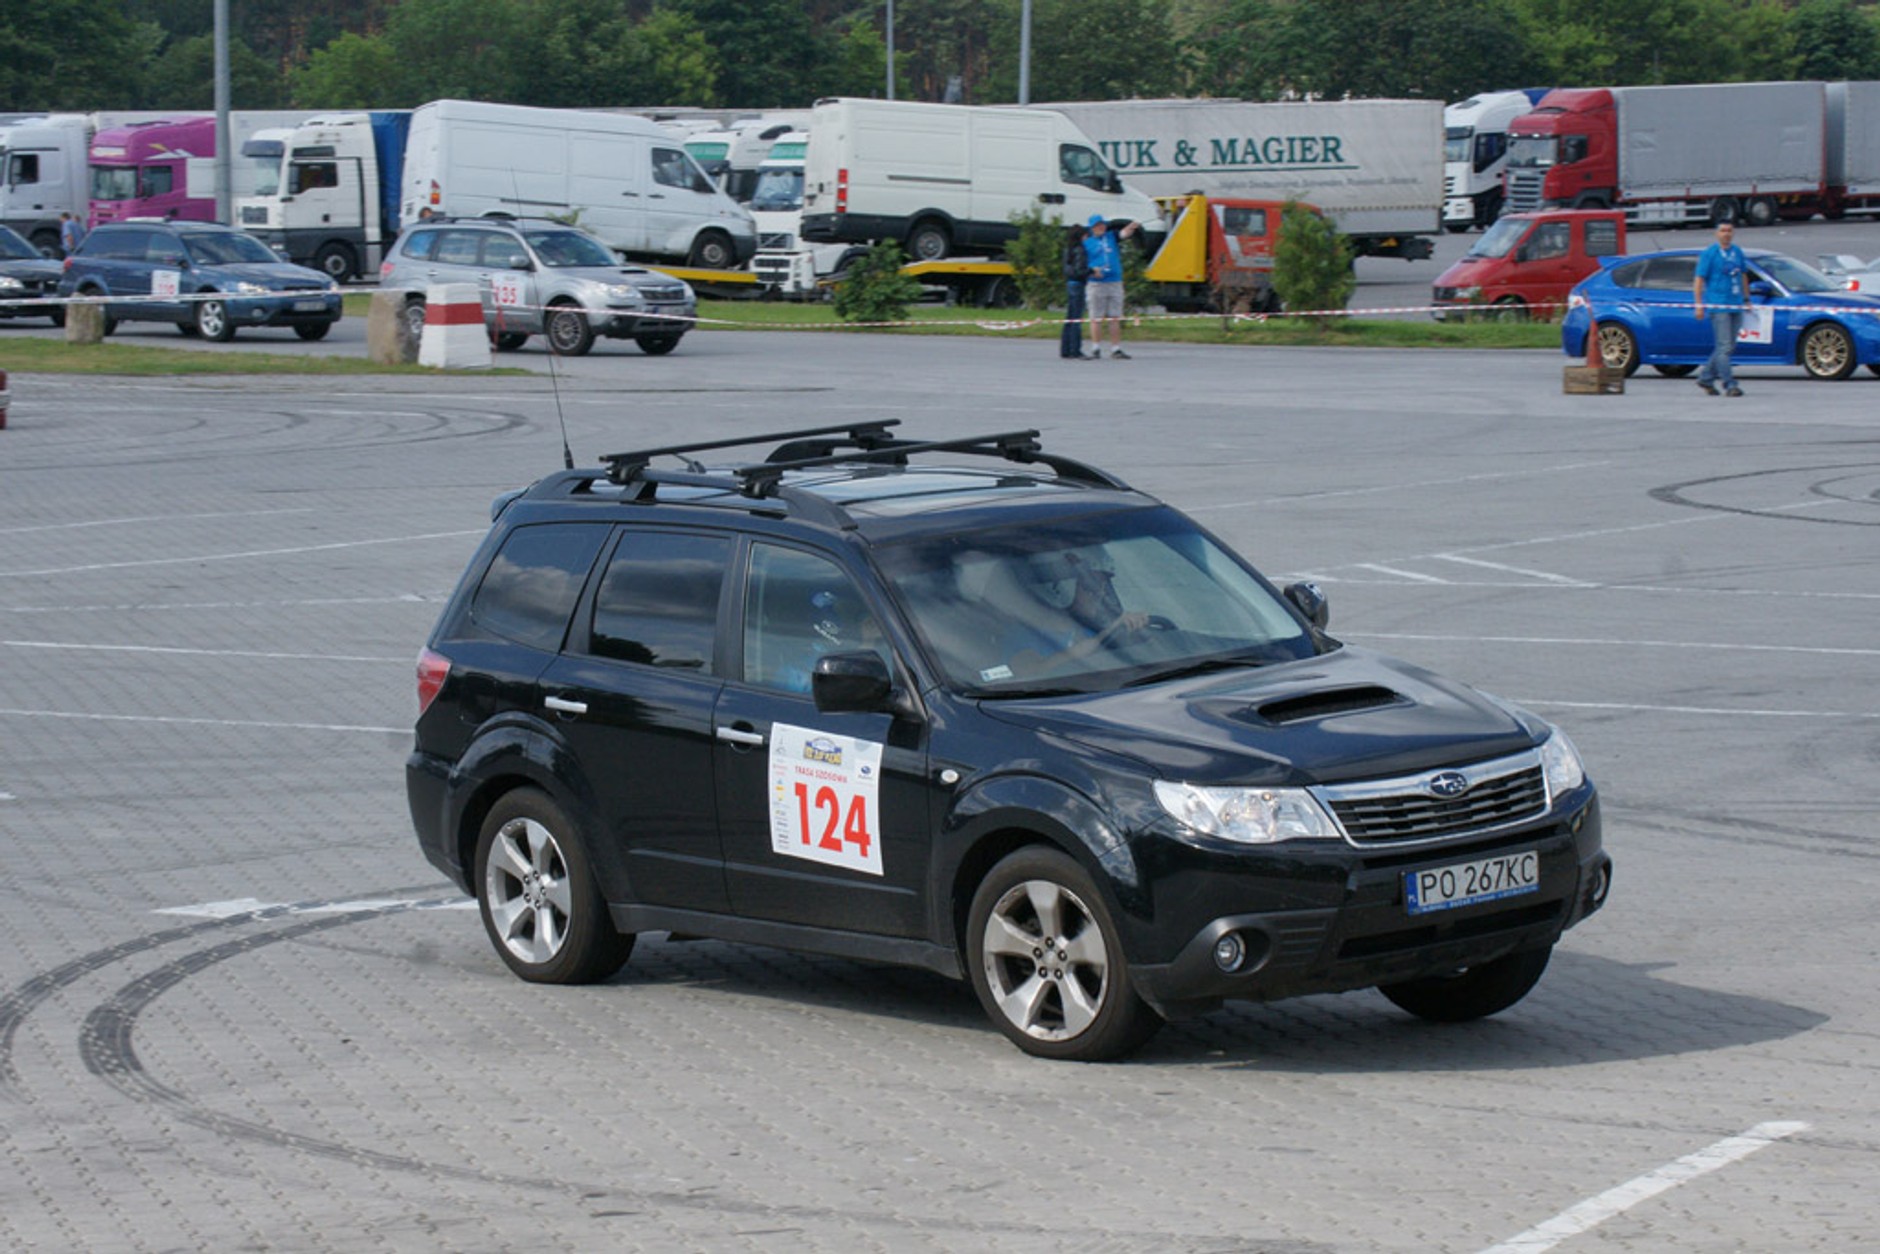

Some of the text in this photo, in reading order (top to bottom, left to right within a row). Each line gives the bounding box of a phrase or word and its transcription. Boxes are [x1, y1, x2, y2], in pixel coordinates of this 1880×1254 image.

[1174, 139, 1198, 166] &
[1210, 136, 1344, 166] MAGIER
[794, 782, 871, 857] 124
[1420, 855, 1535, 903] PO 267KC
